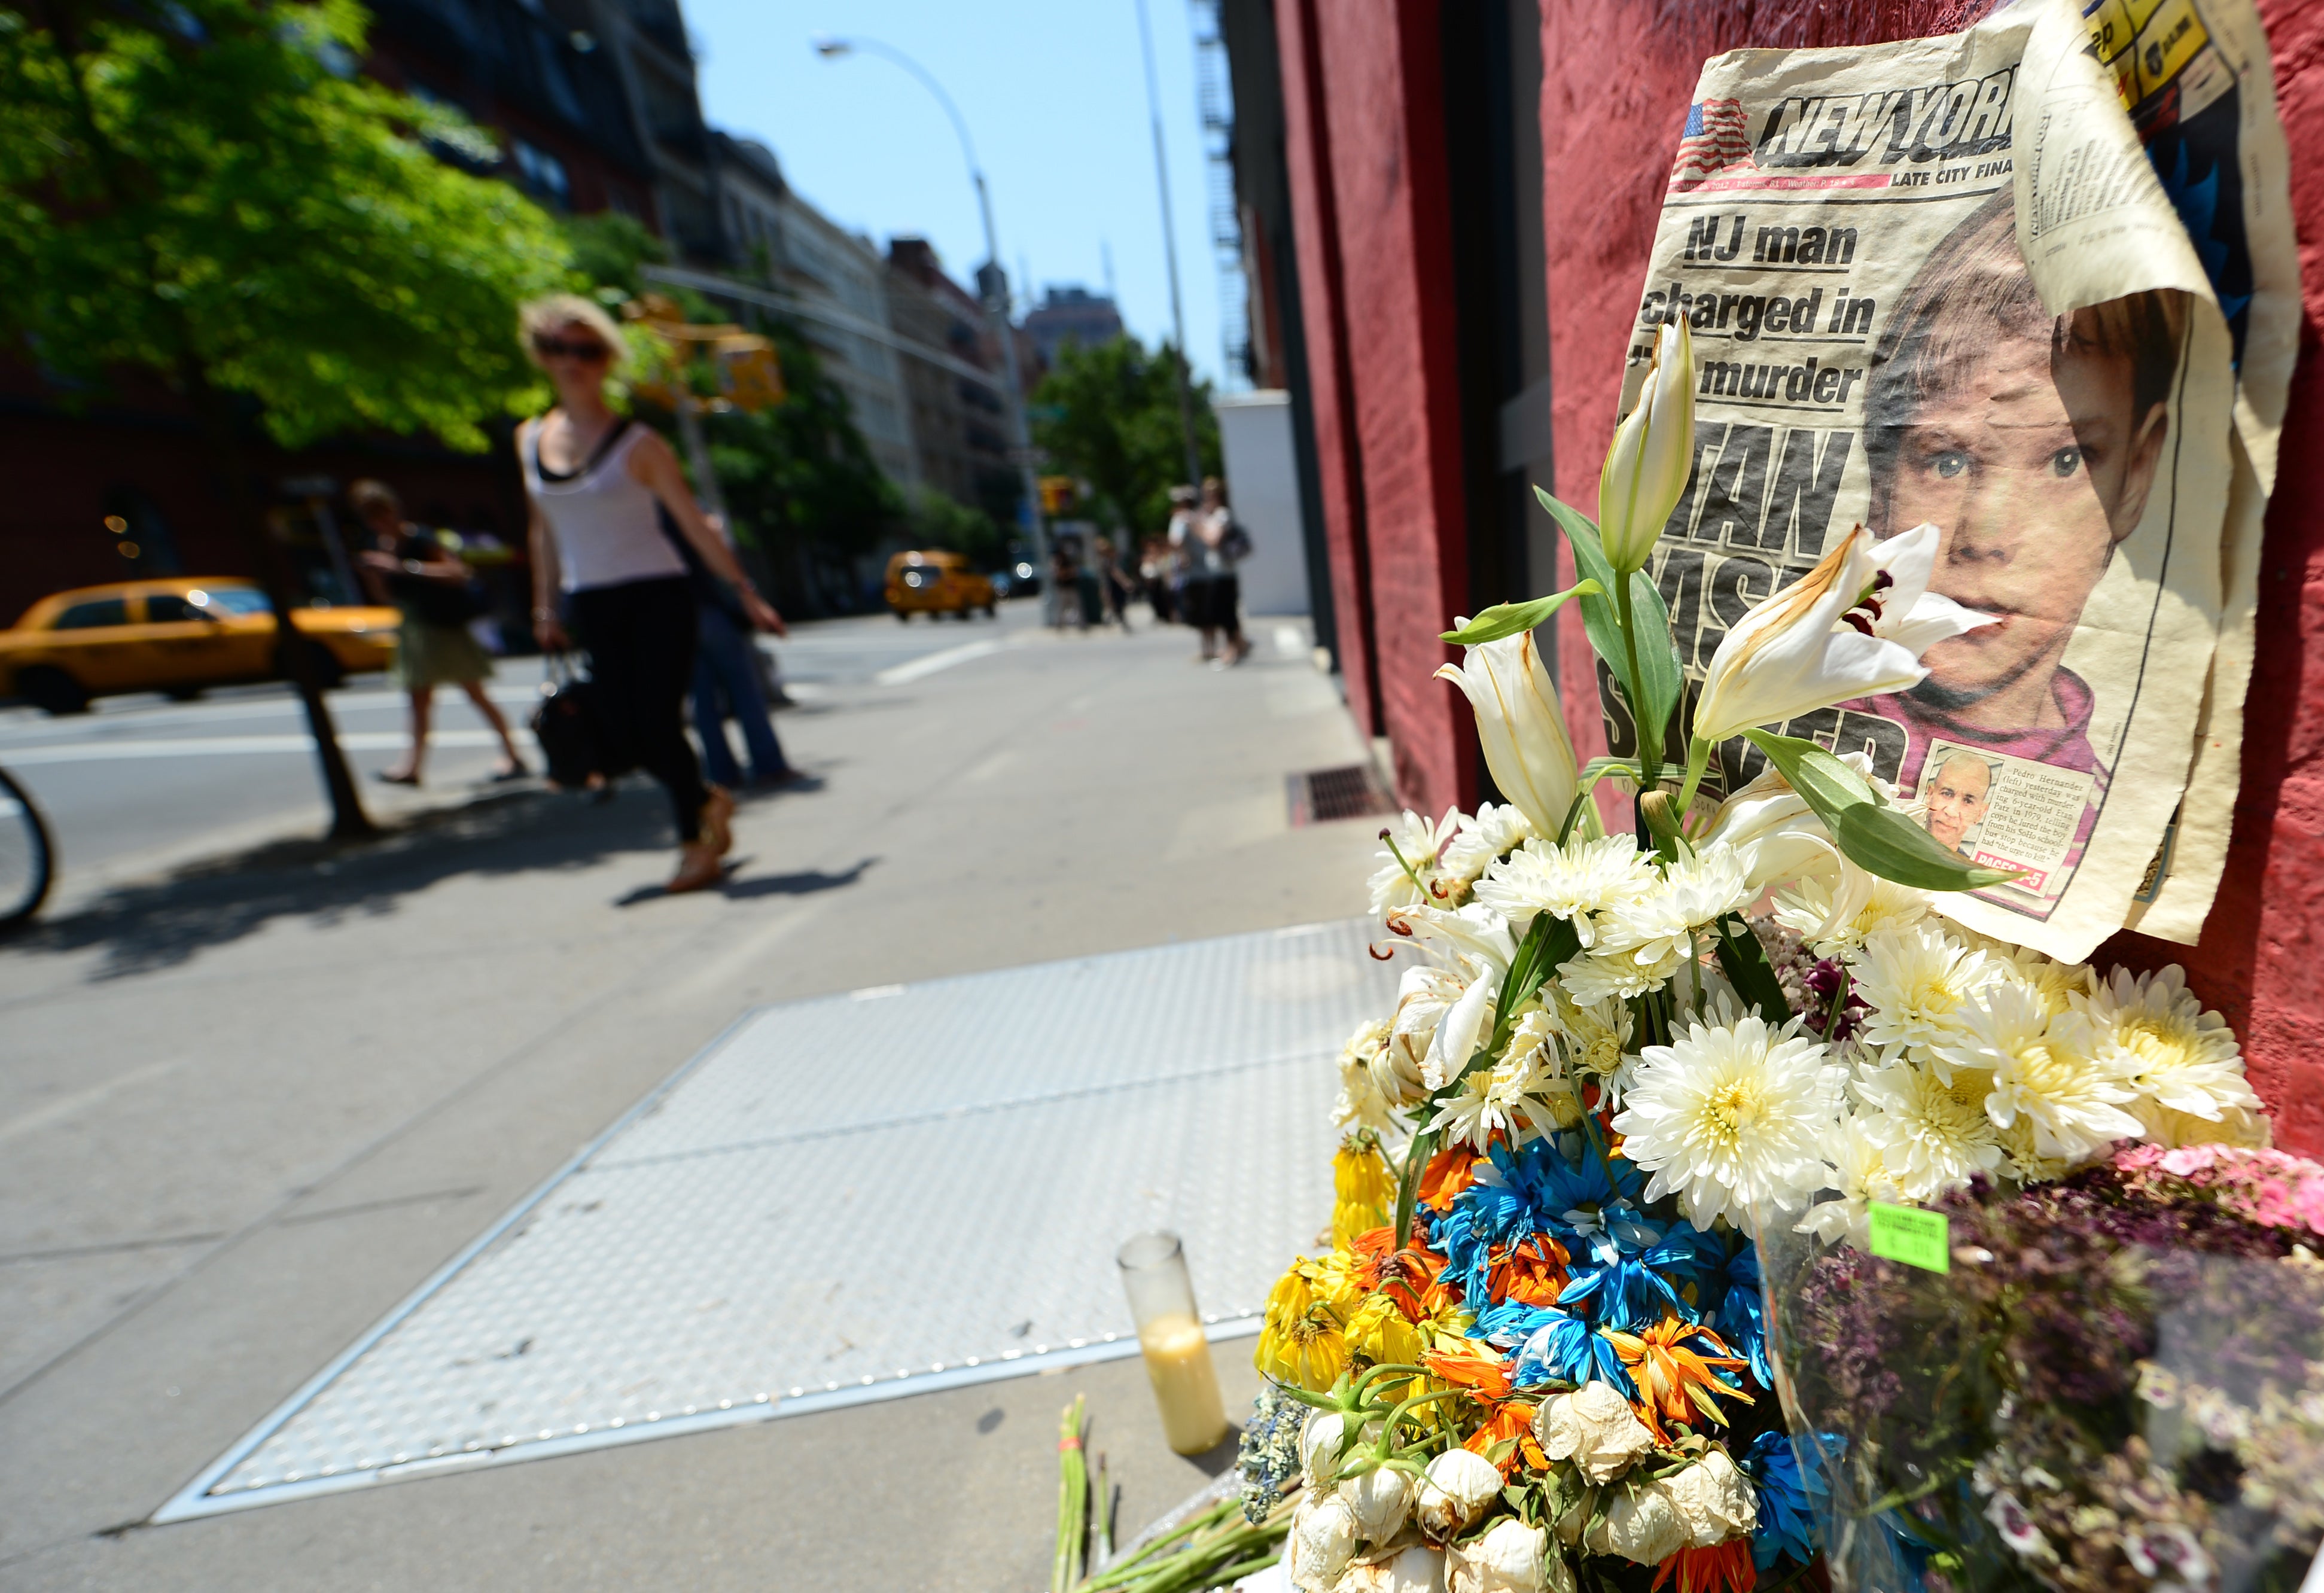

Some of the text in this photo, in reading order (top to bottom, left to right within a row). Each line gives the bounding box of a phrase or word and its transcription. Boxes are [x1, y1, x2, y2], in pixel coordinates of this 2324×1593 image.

[1758, 91, 1902, 168] NEW
[1711, 181, 1729, 190] 2012
[1891, 172, 1932, 187] LATE
[1935, 167, 1971, 186] CITY
[1683, 215, 1859, 265] NJ man
[1641, 282, 1876, 342] charged in
[1699, 357, 1863, 403] murder
[1616, 412, 1856, 559] TAN
[2003, 775, 2081, 802] (left) yesterday was
[2012, 767, 2083, 791] Pedro Hernandez
[1996, 794, 2073, 820] ing 6-year-old Etan
[2000, 785, 2076, 809] charged with murder-
[1991, 812, 2006, 822] cops
[2020, 820, 2039, 831] lured
[2040, 825, 2051, 834] the
[2052, 829, 2067, 840] boy
[1994, 802, 2009, 812] Patz
[2024, 810, 2042, 822] 1979,
[2046, 818, 2070, 831] telling
[1982, 837, 1993, 847] had
[2009, 846, 2024, 857] urge
[1985, 829, 2060, 857] bus stop because he
[1988, 821, 2063, 847] from his SoHo school-
